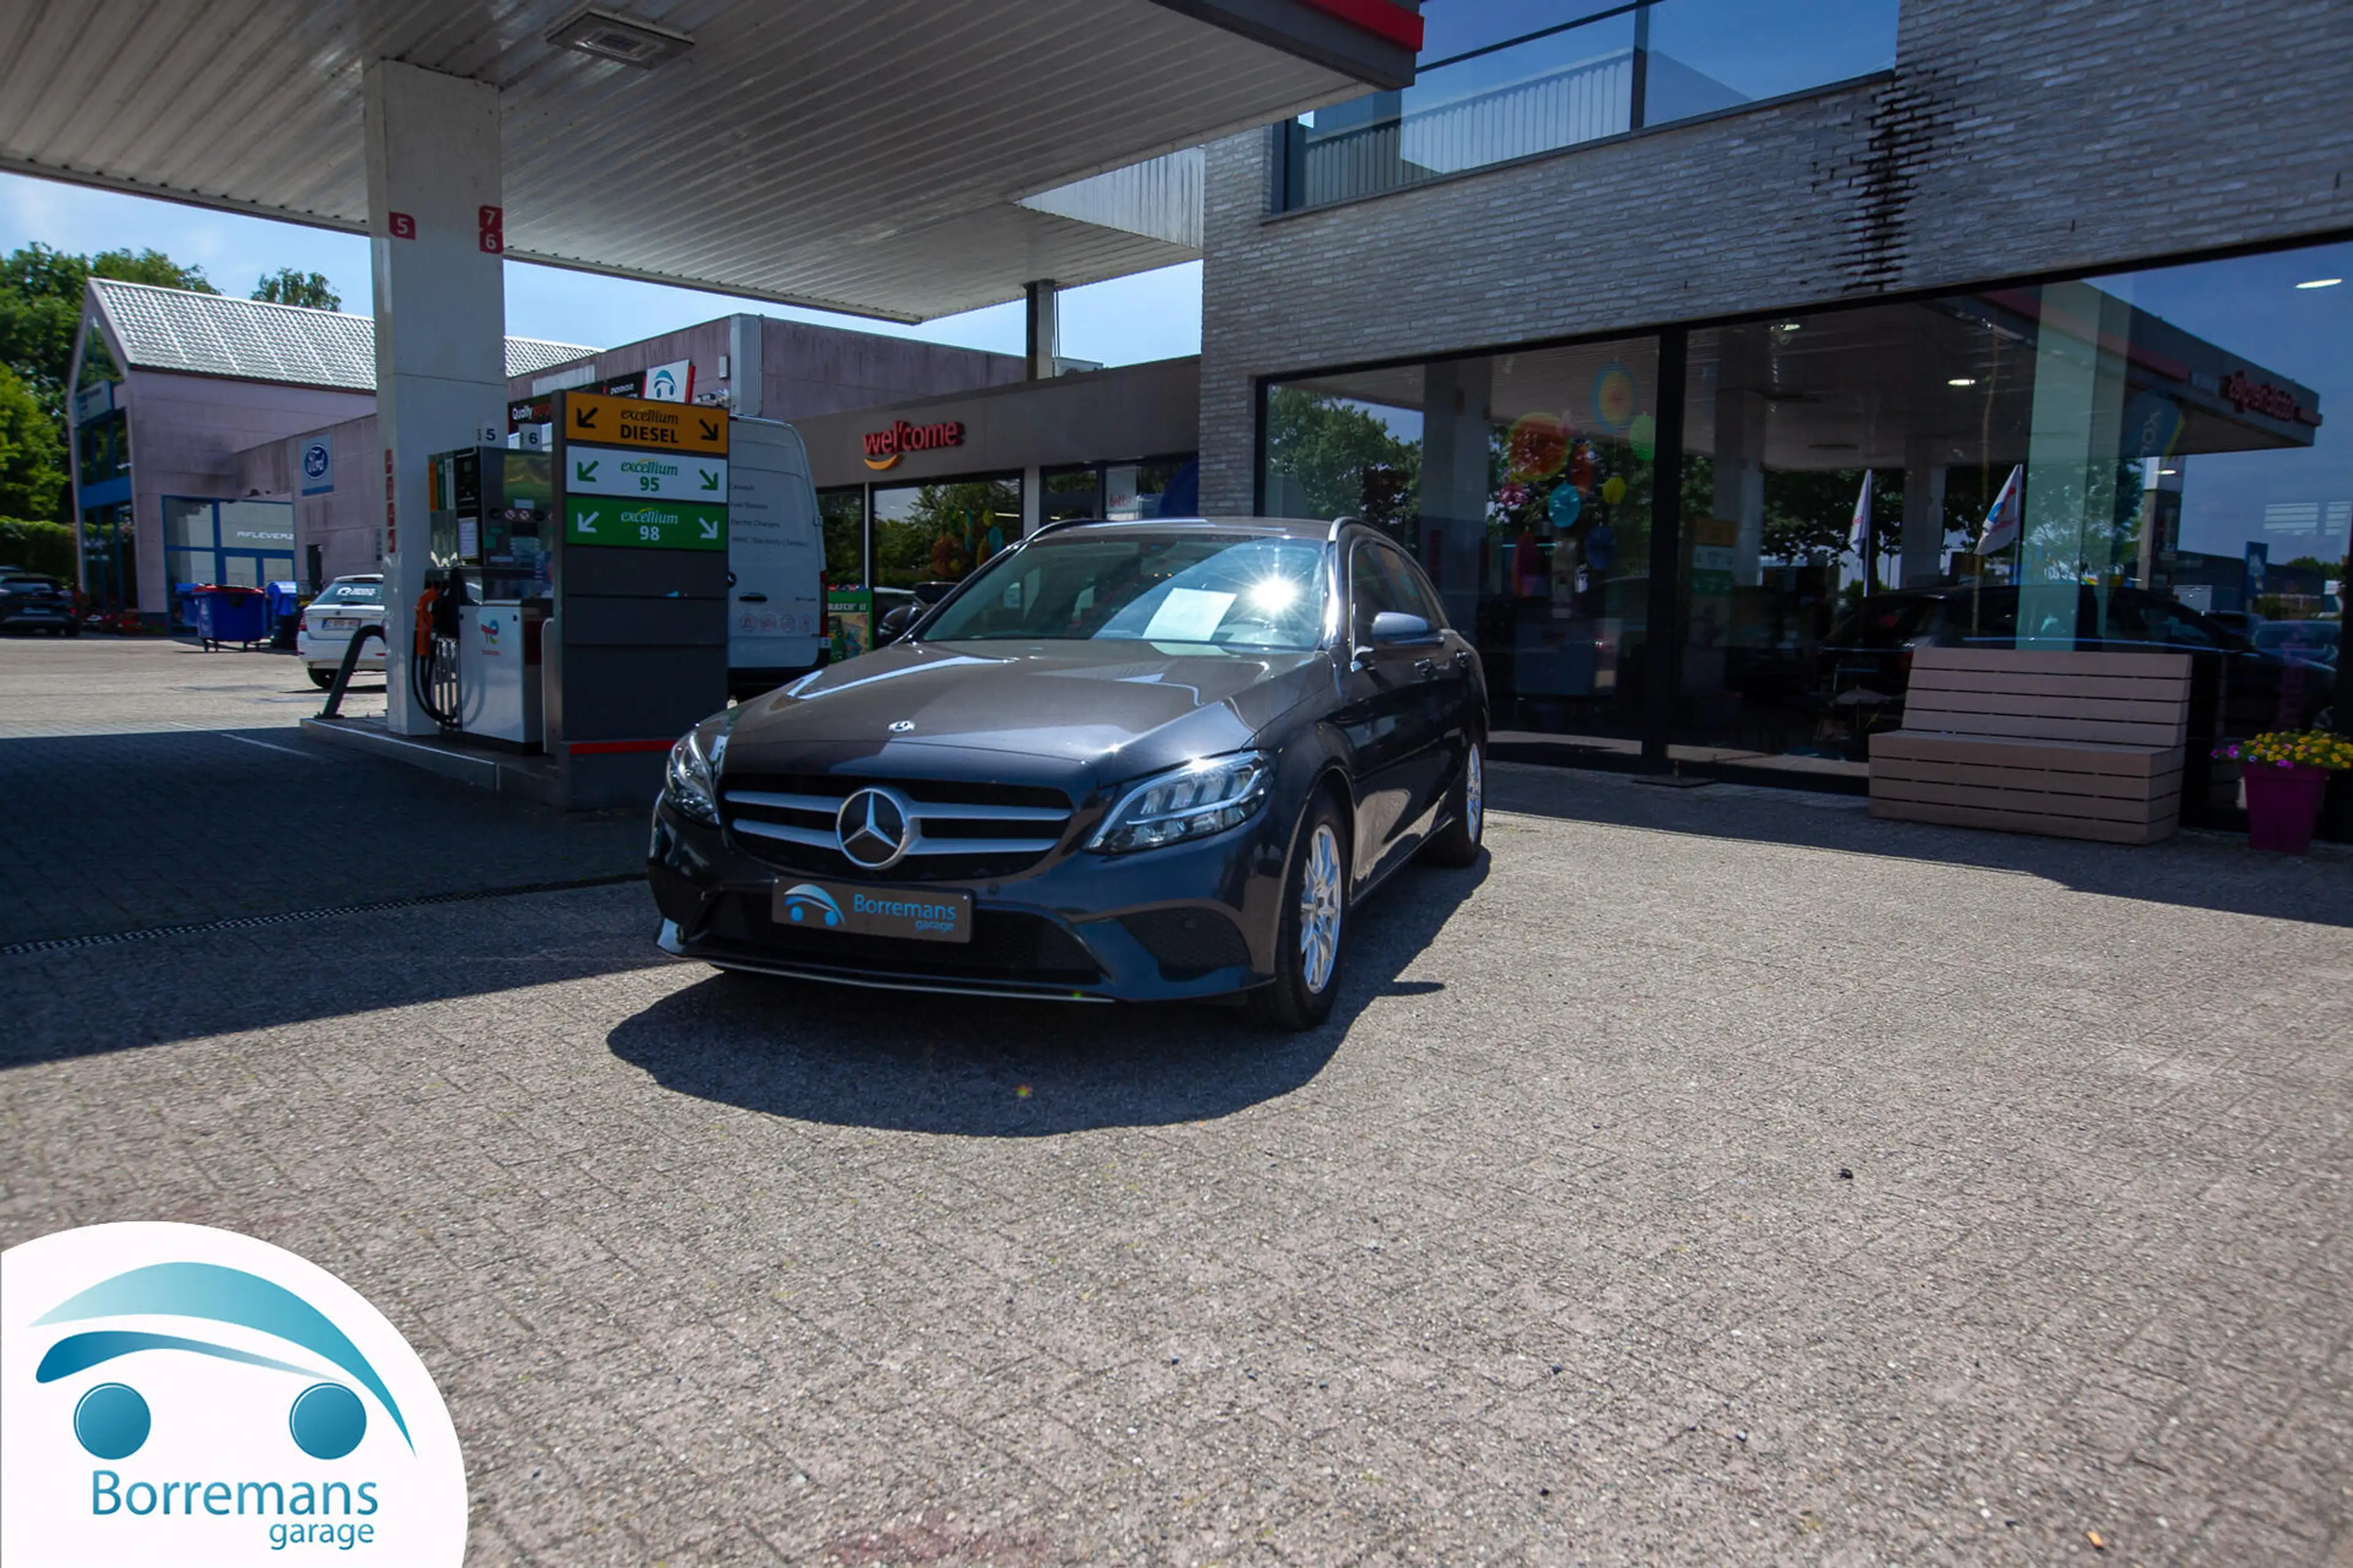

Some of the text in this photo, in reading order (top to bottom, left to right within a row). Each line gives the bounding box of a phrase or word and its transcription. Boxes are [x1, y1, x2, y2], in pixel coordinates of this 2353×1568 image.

[484, 208, 496, 226] 7
[396, 218, 409, 235] 5
[485, 233, 496, 250] 6
[620, 408, 678, 425] excellium
[486, 428, 496, 441] 5
[528, 432, 539, 444] 6
[620, 423, 680, 444] DIESEL
[620, 461, 678, 476] excellium
[640, 476, 660, 491] 95
[620, 510, 678, 525] excellium
[639, 525, 660, 541] 98
[853, 893, 957, 921] Borremans
[915, 920, 955, 933] garage
